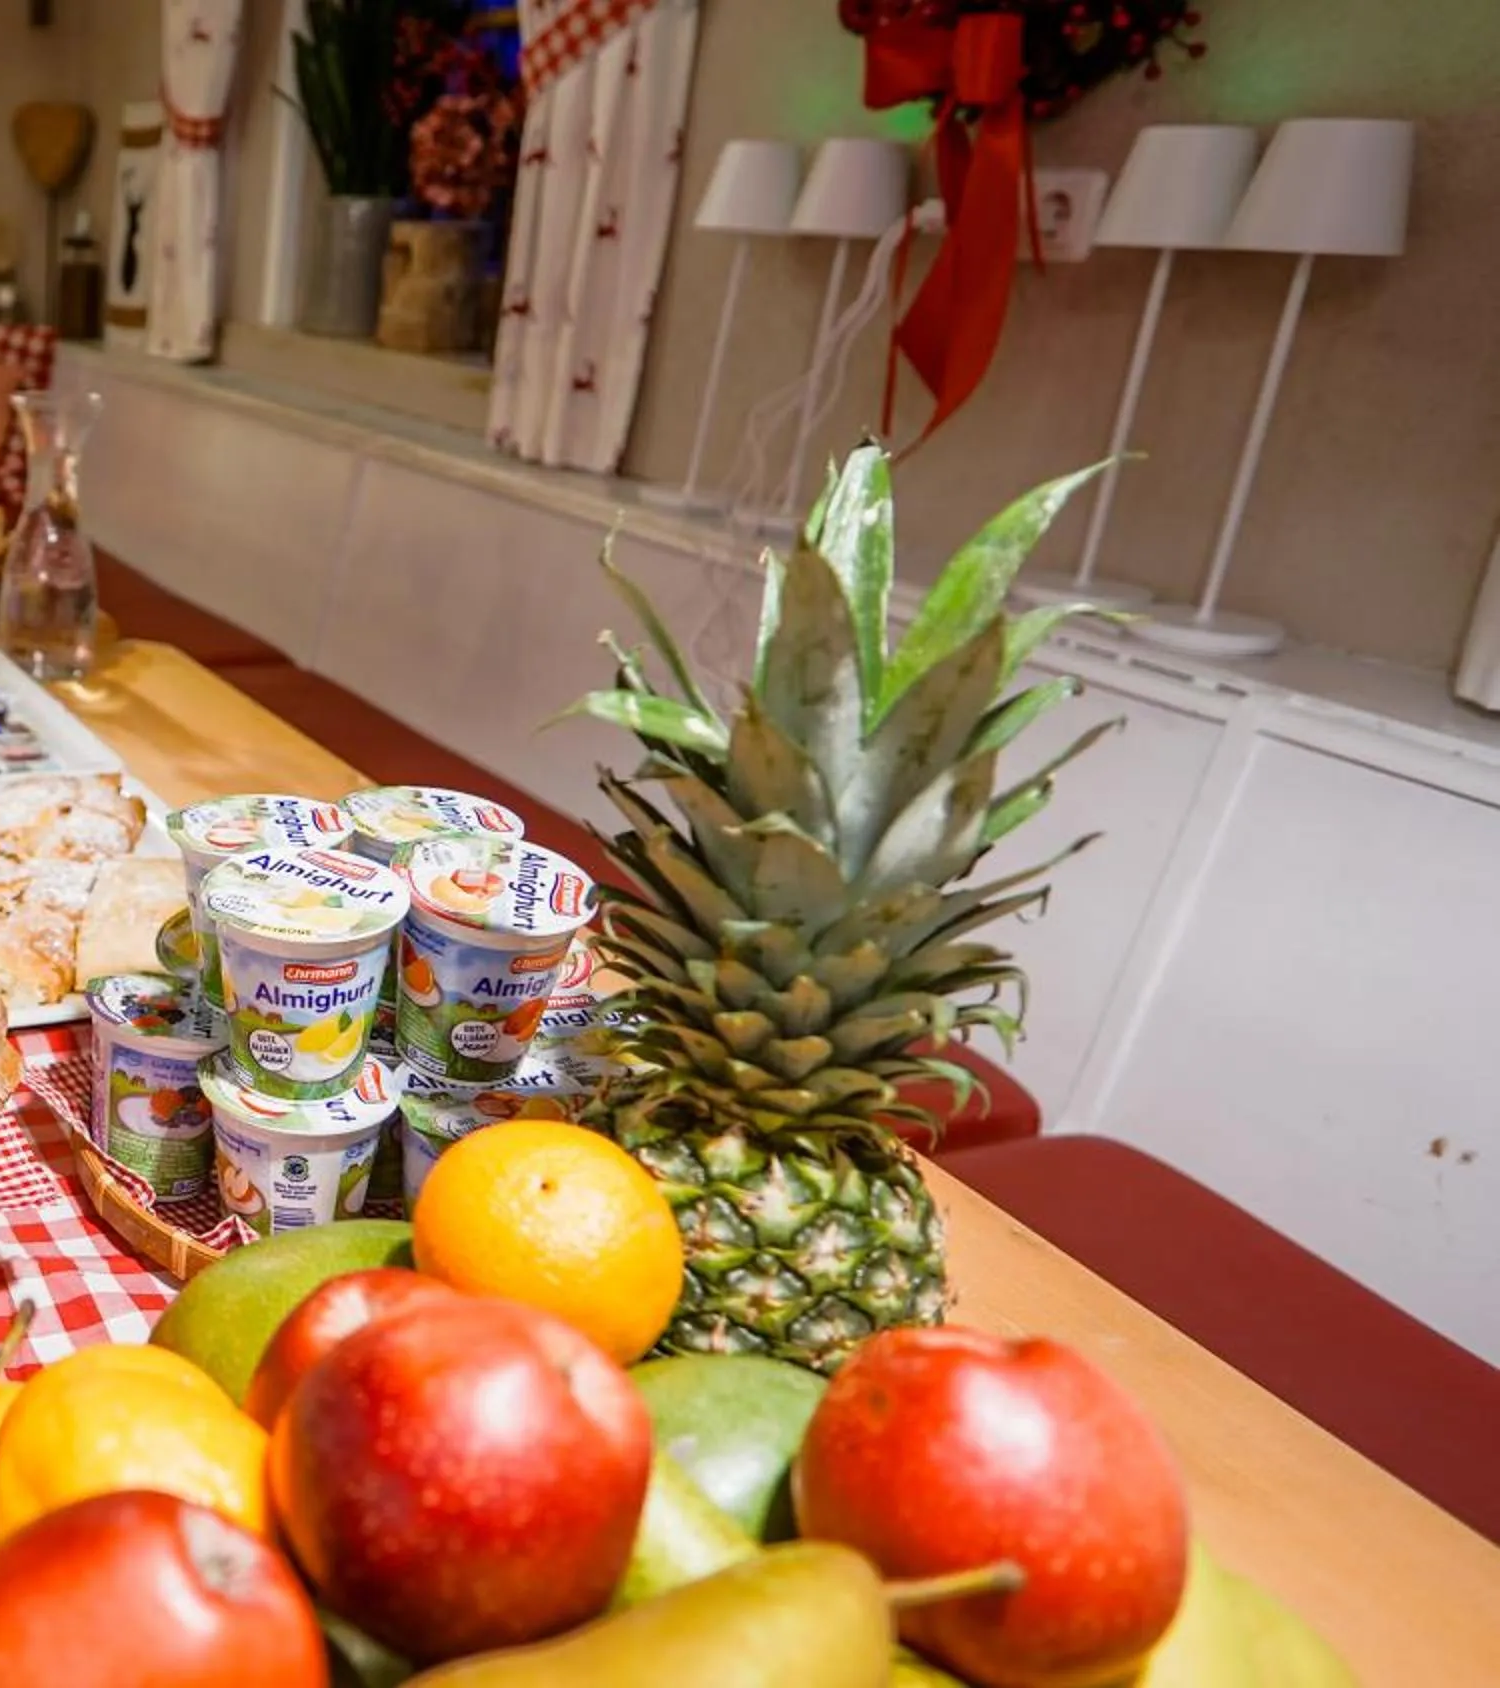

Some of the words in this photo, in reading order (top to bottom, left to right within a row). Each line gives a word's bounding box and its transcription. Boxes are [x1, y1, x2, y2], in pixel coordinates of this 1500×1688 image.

[247, 853, 395, 904] Almighurt
[508, 850, 548, 931] Almighurt
[285, 963, 354, 981] Ehrmann
[255, 976, 375, 1014] Almighurt
